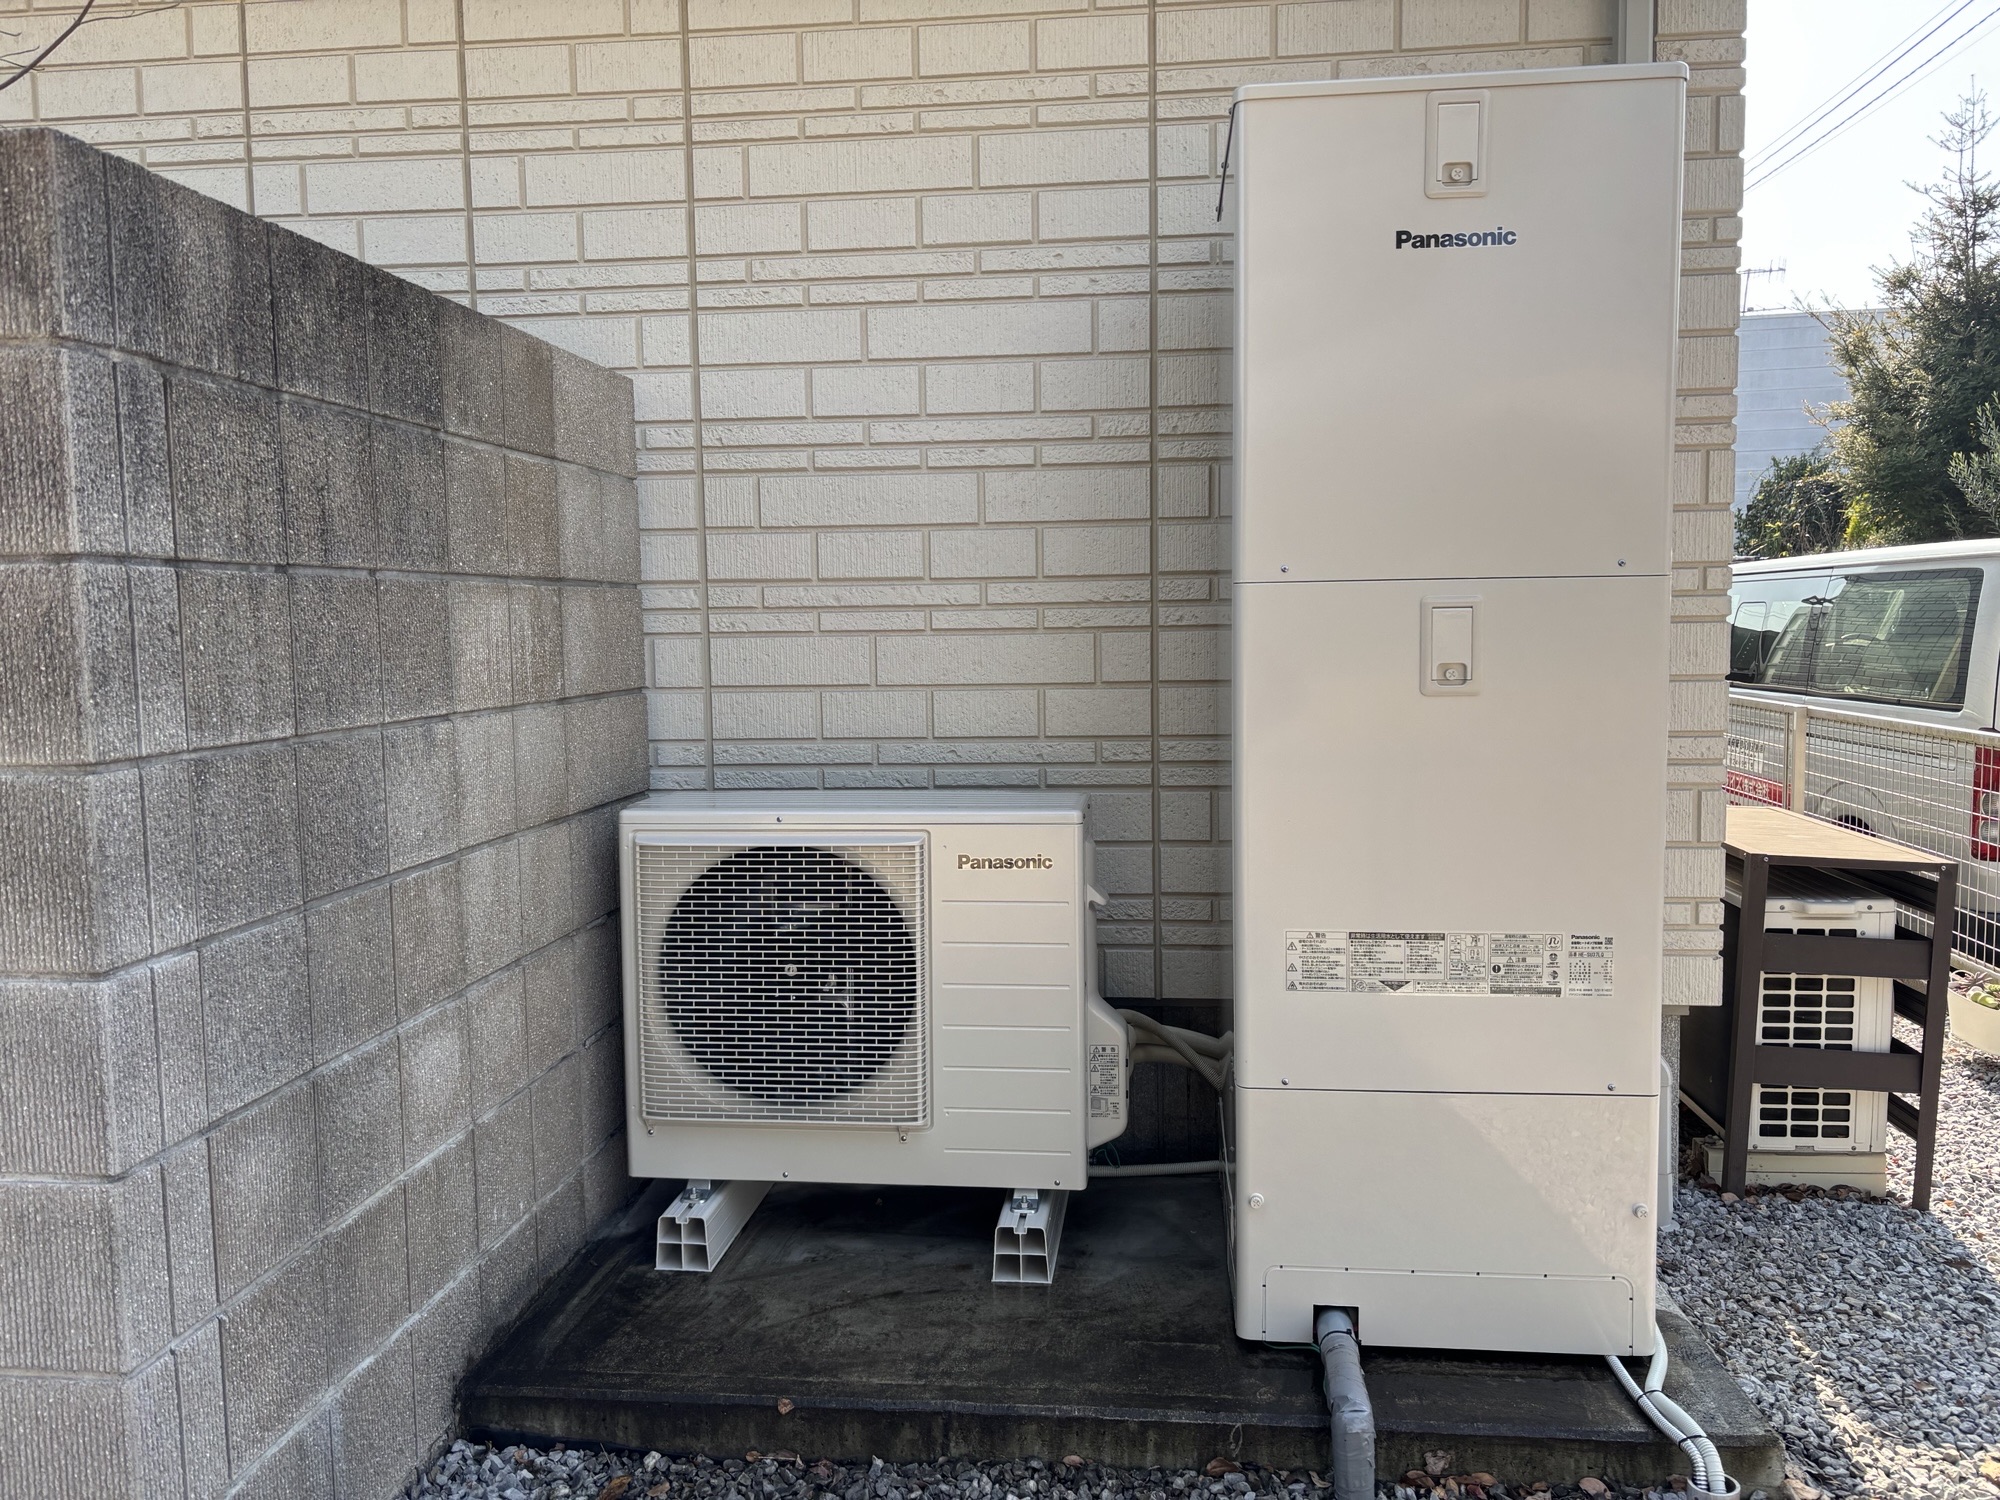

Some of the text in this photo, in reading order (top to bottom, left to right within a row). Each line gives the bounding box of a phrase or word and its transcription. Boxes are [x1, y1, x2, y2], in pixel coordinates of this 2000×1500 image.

[1396, 226, 1517, 249] Panasonic
[1728, 774, 1770, 799] イズ株式会社
[957, 853, 1053, 870] Panasonic
